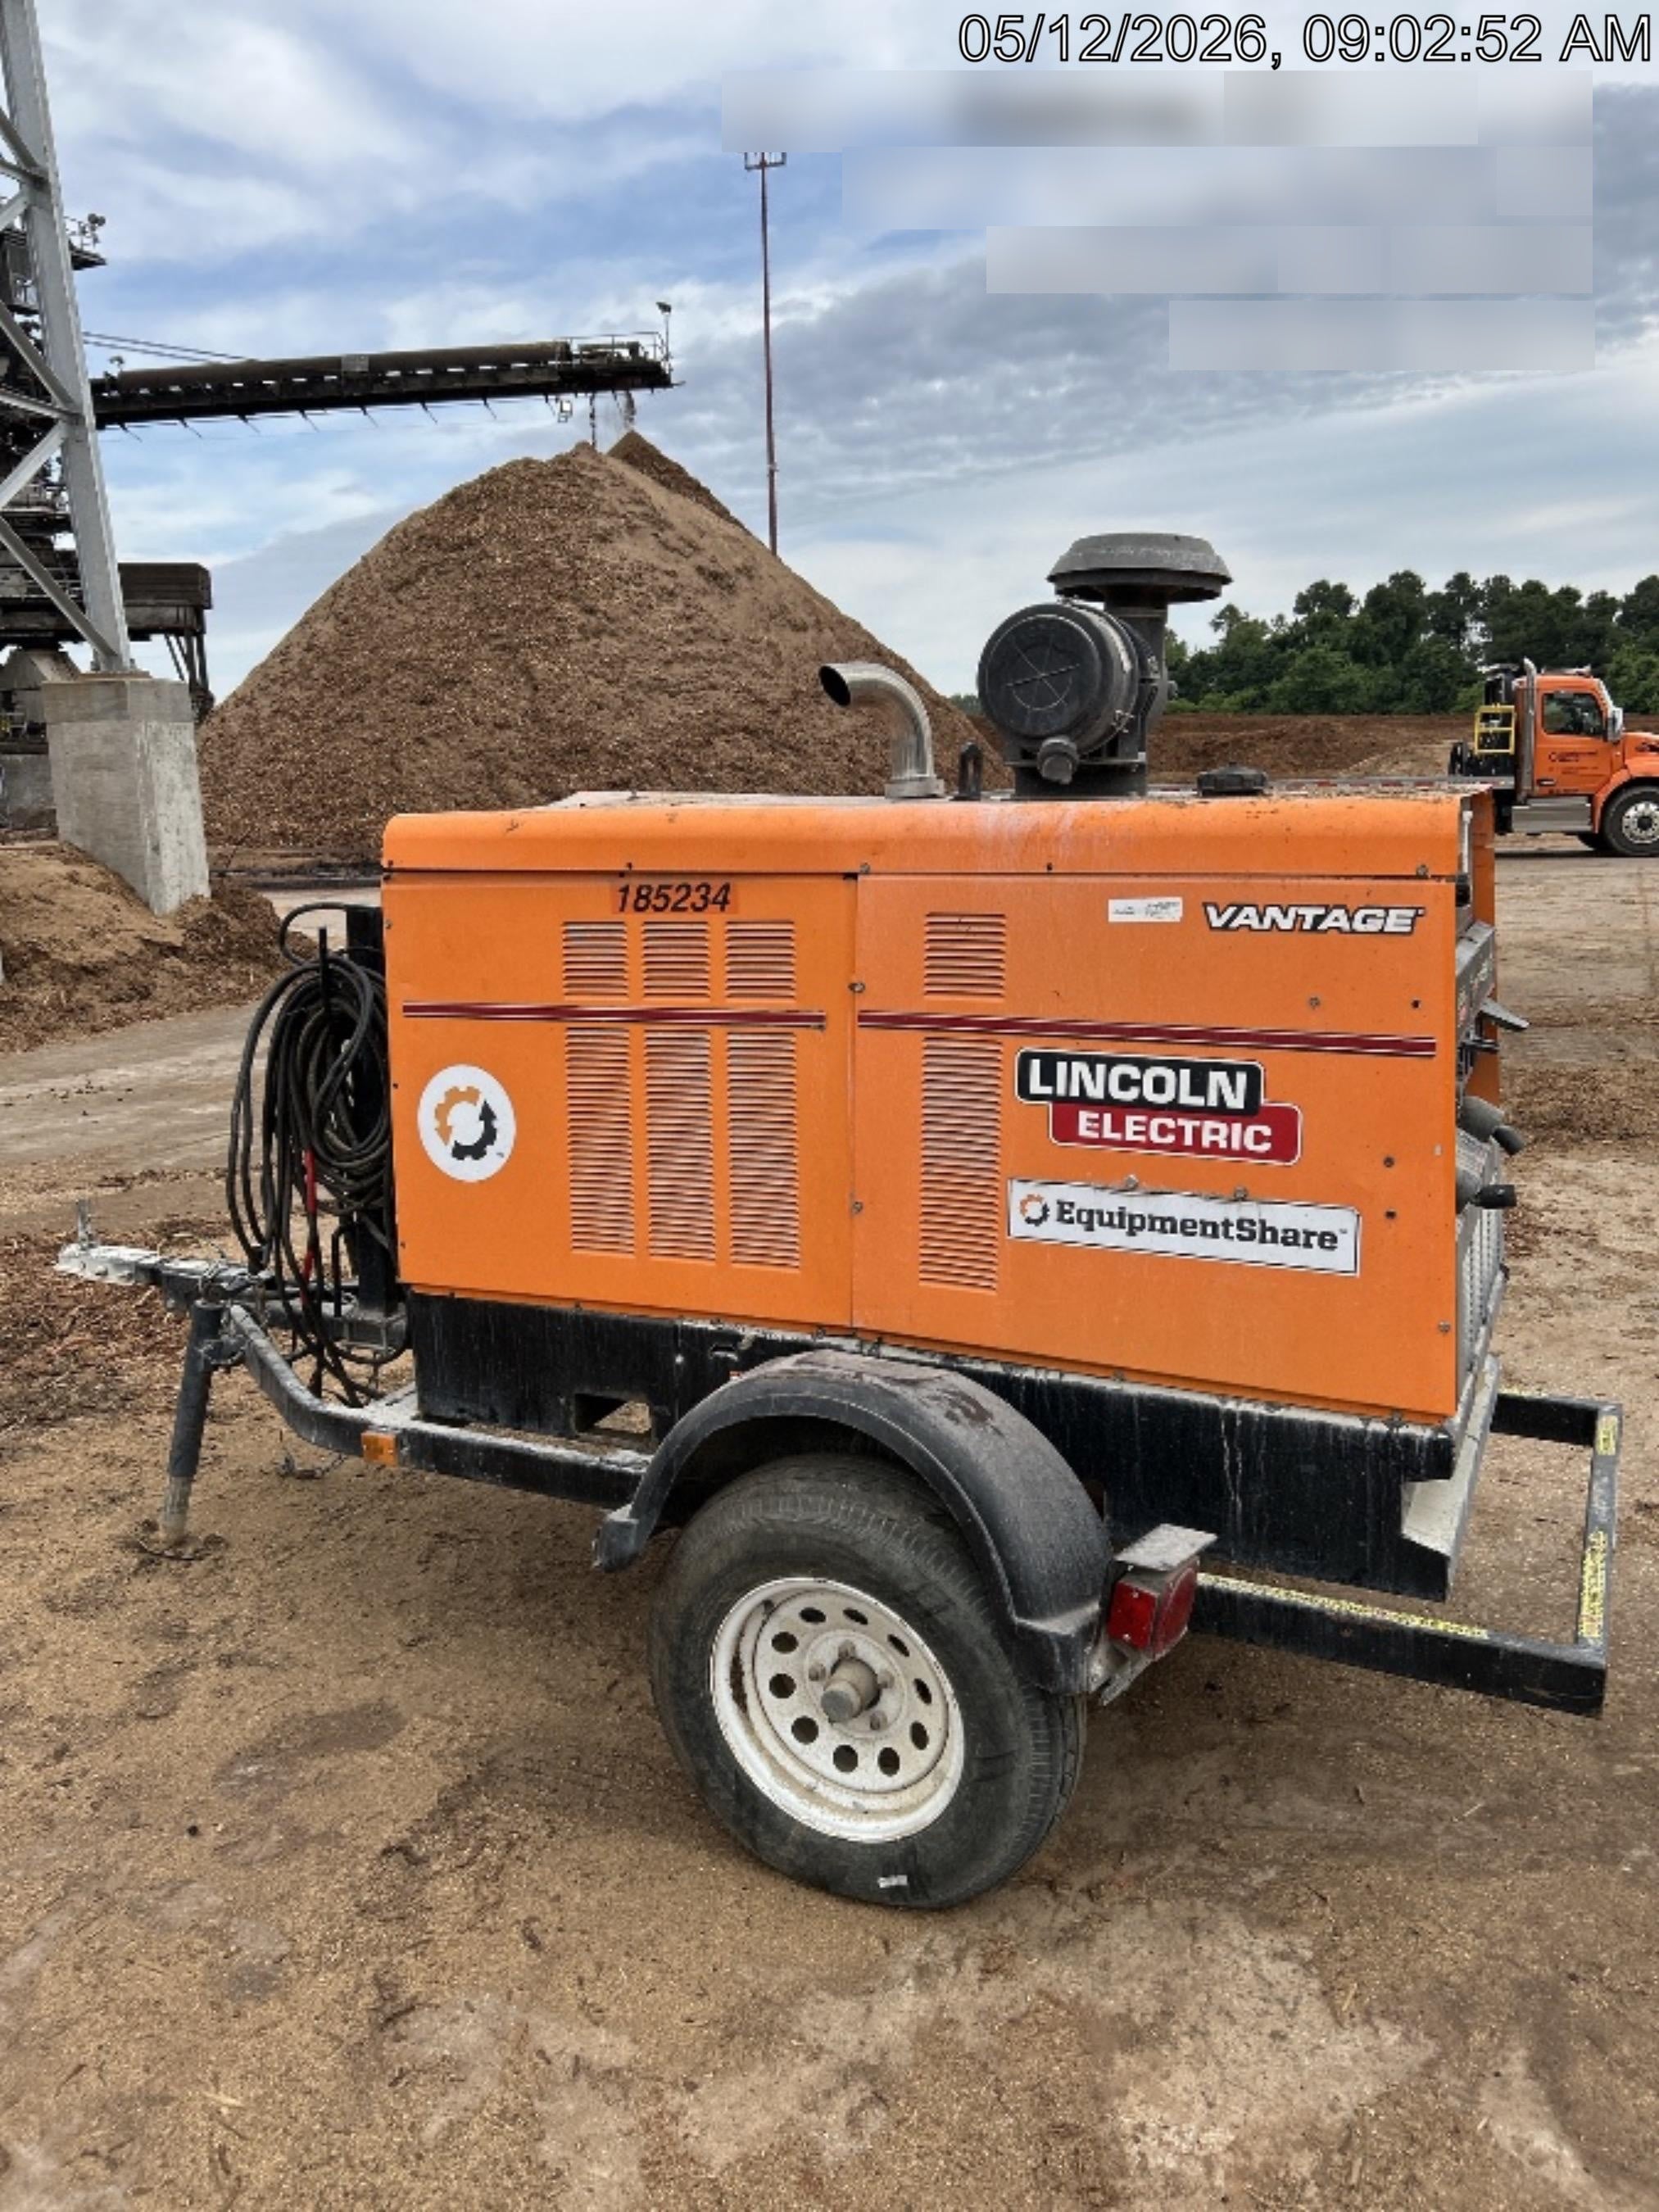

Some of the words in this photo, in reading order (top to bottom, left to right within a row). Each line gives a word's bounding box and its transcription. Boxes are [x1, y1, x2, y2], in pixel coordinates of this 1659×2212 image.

[618, 882, 731, 912] 185234
[1203, 903, 1421, 934] VANTAGE
[1028, 1058, 1248, 1109] LINCOLN
[1077, 1109, 1273, 1154] ELECTRIC
